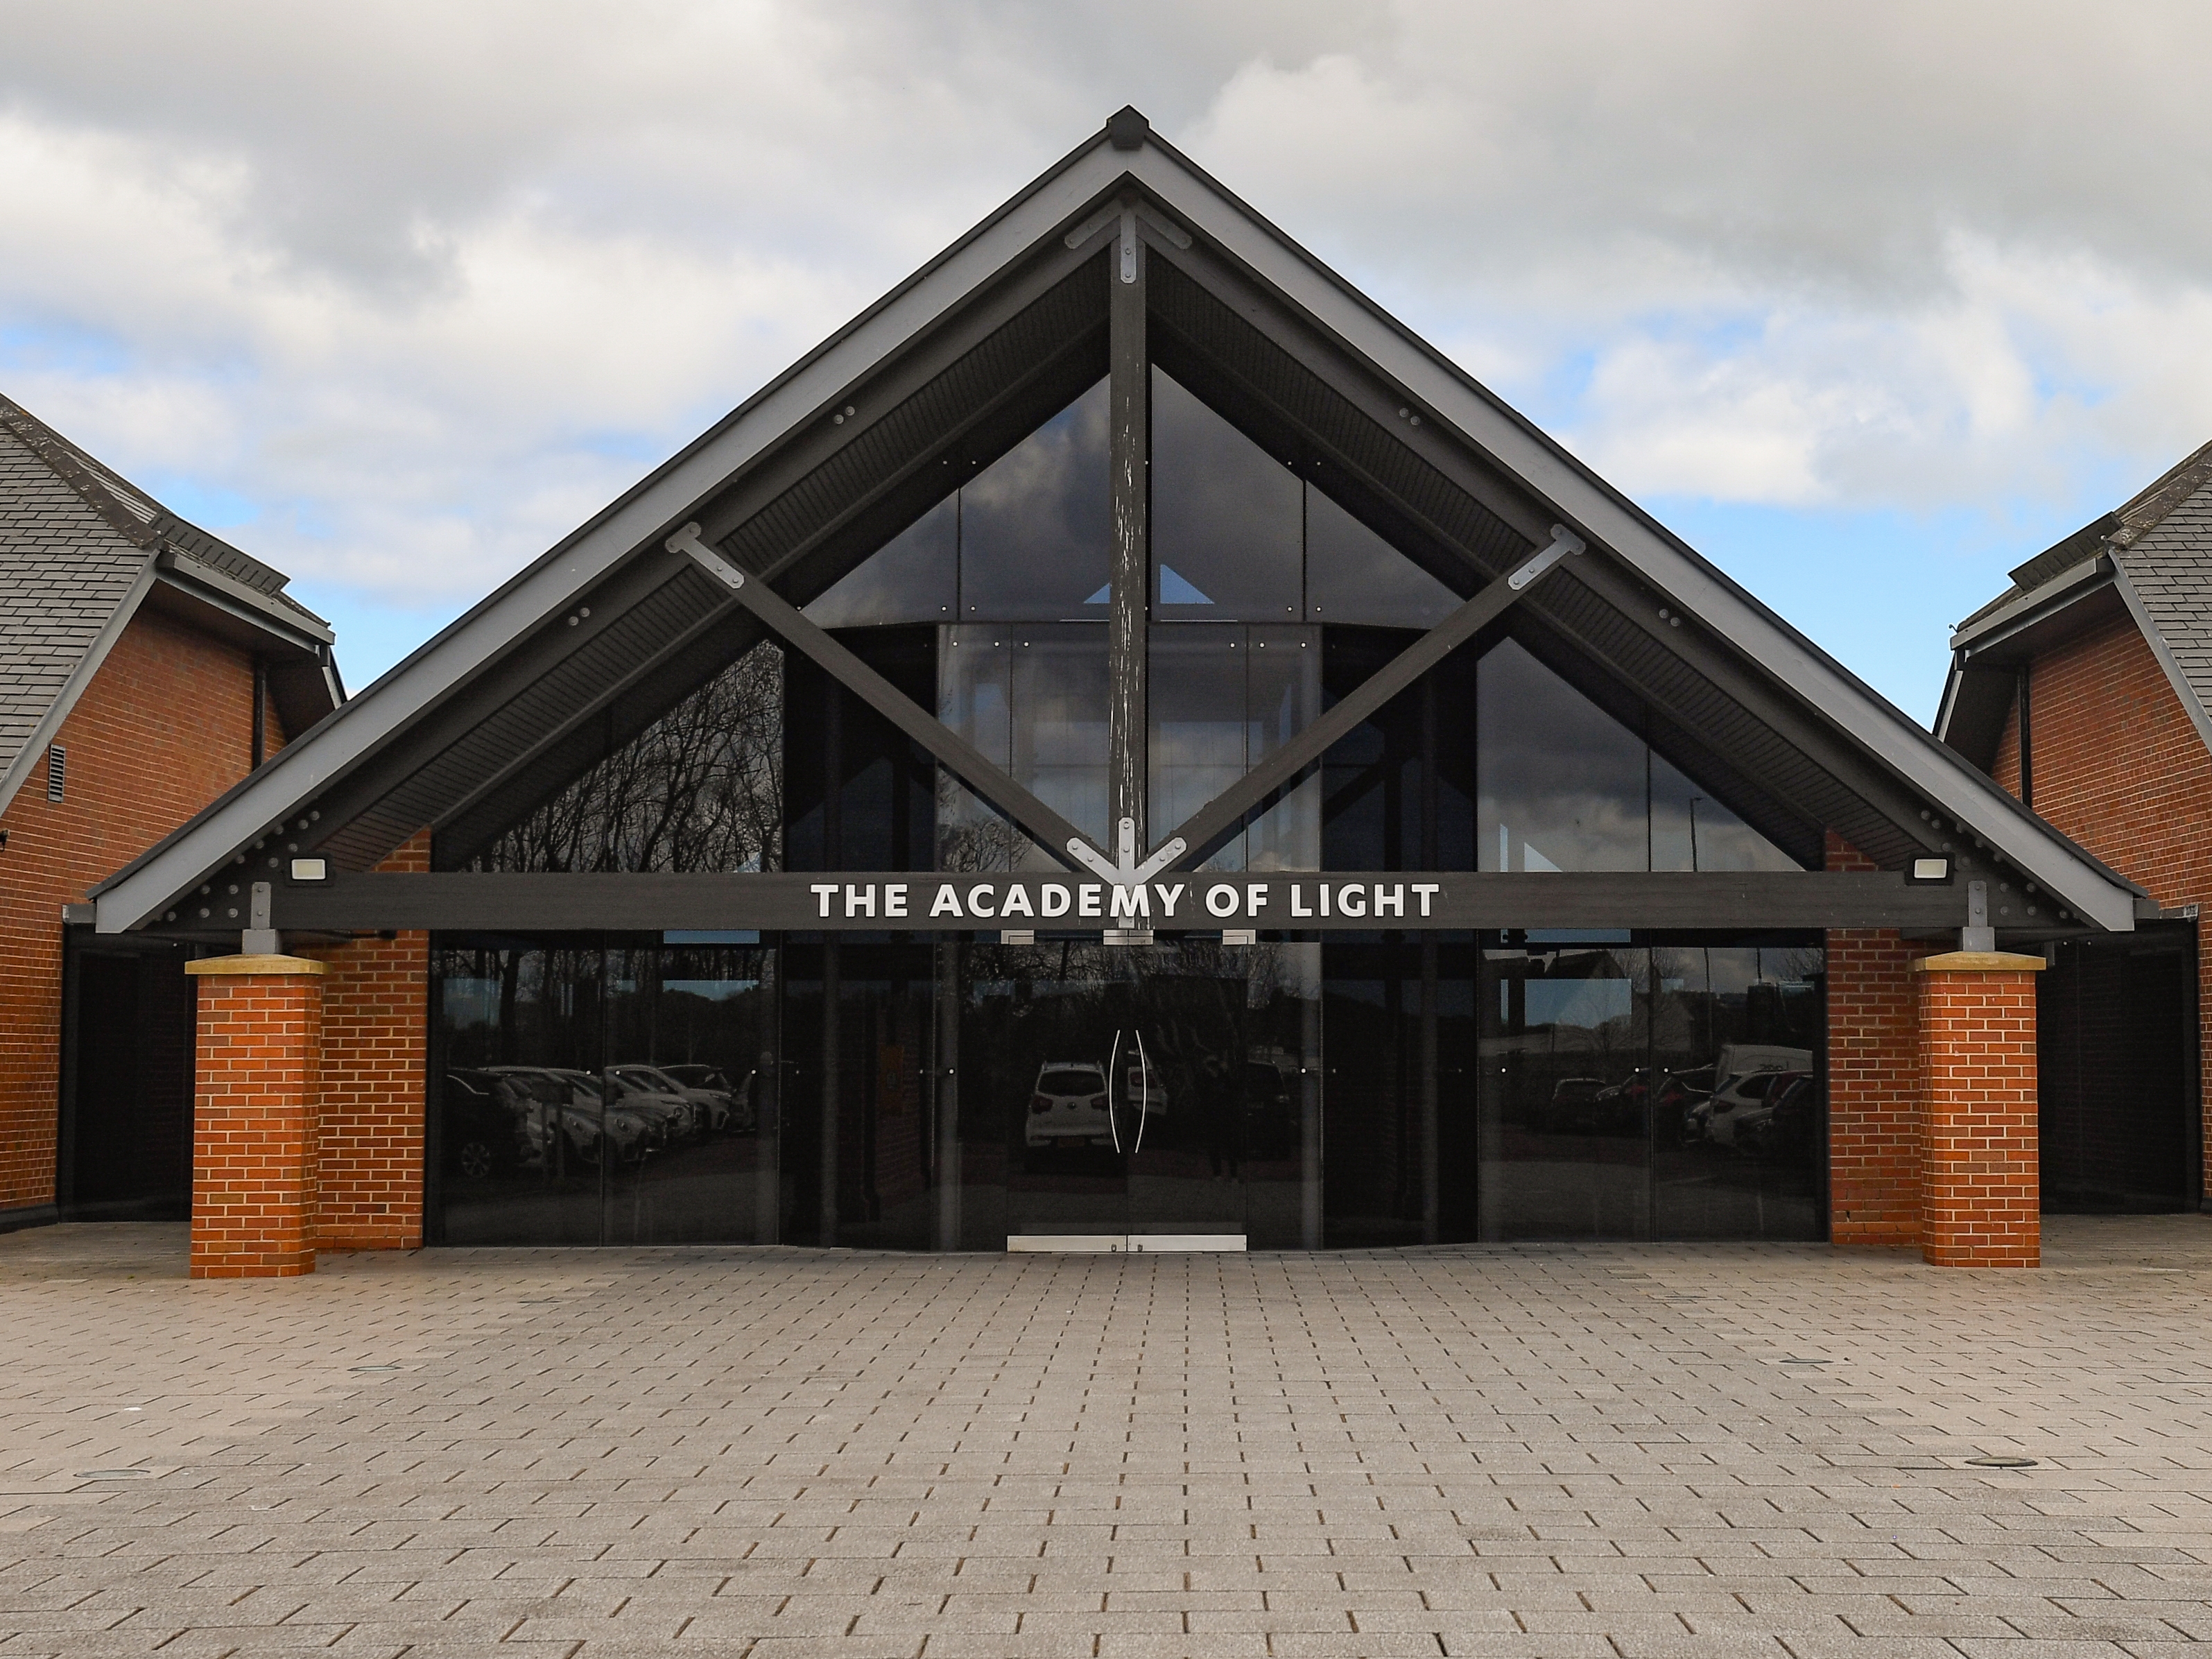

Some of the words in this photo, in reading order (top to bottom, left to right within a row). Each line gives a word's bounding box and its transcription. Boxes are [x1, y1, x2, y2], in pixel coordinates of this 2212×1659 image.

[810, 884, 908, 918] THE
[928, 883, 1185, 918] ACADEMY
[1205, 883, 1269, 918] OF
[1290, 883, 1440, 918] LIGHT
